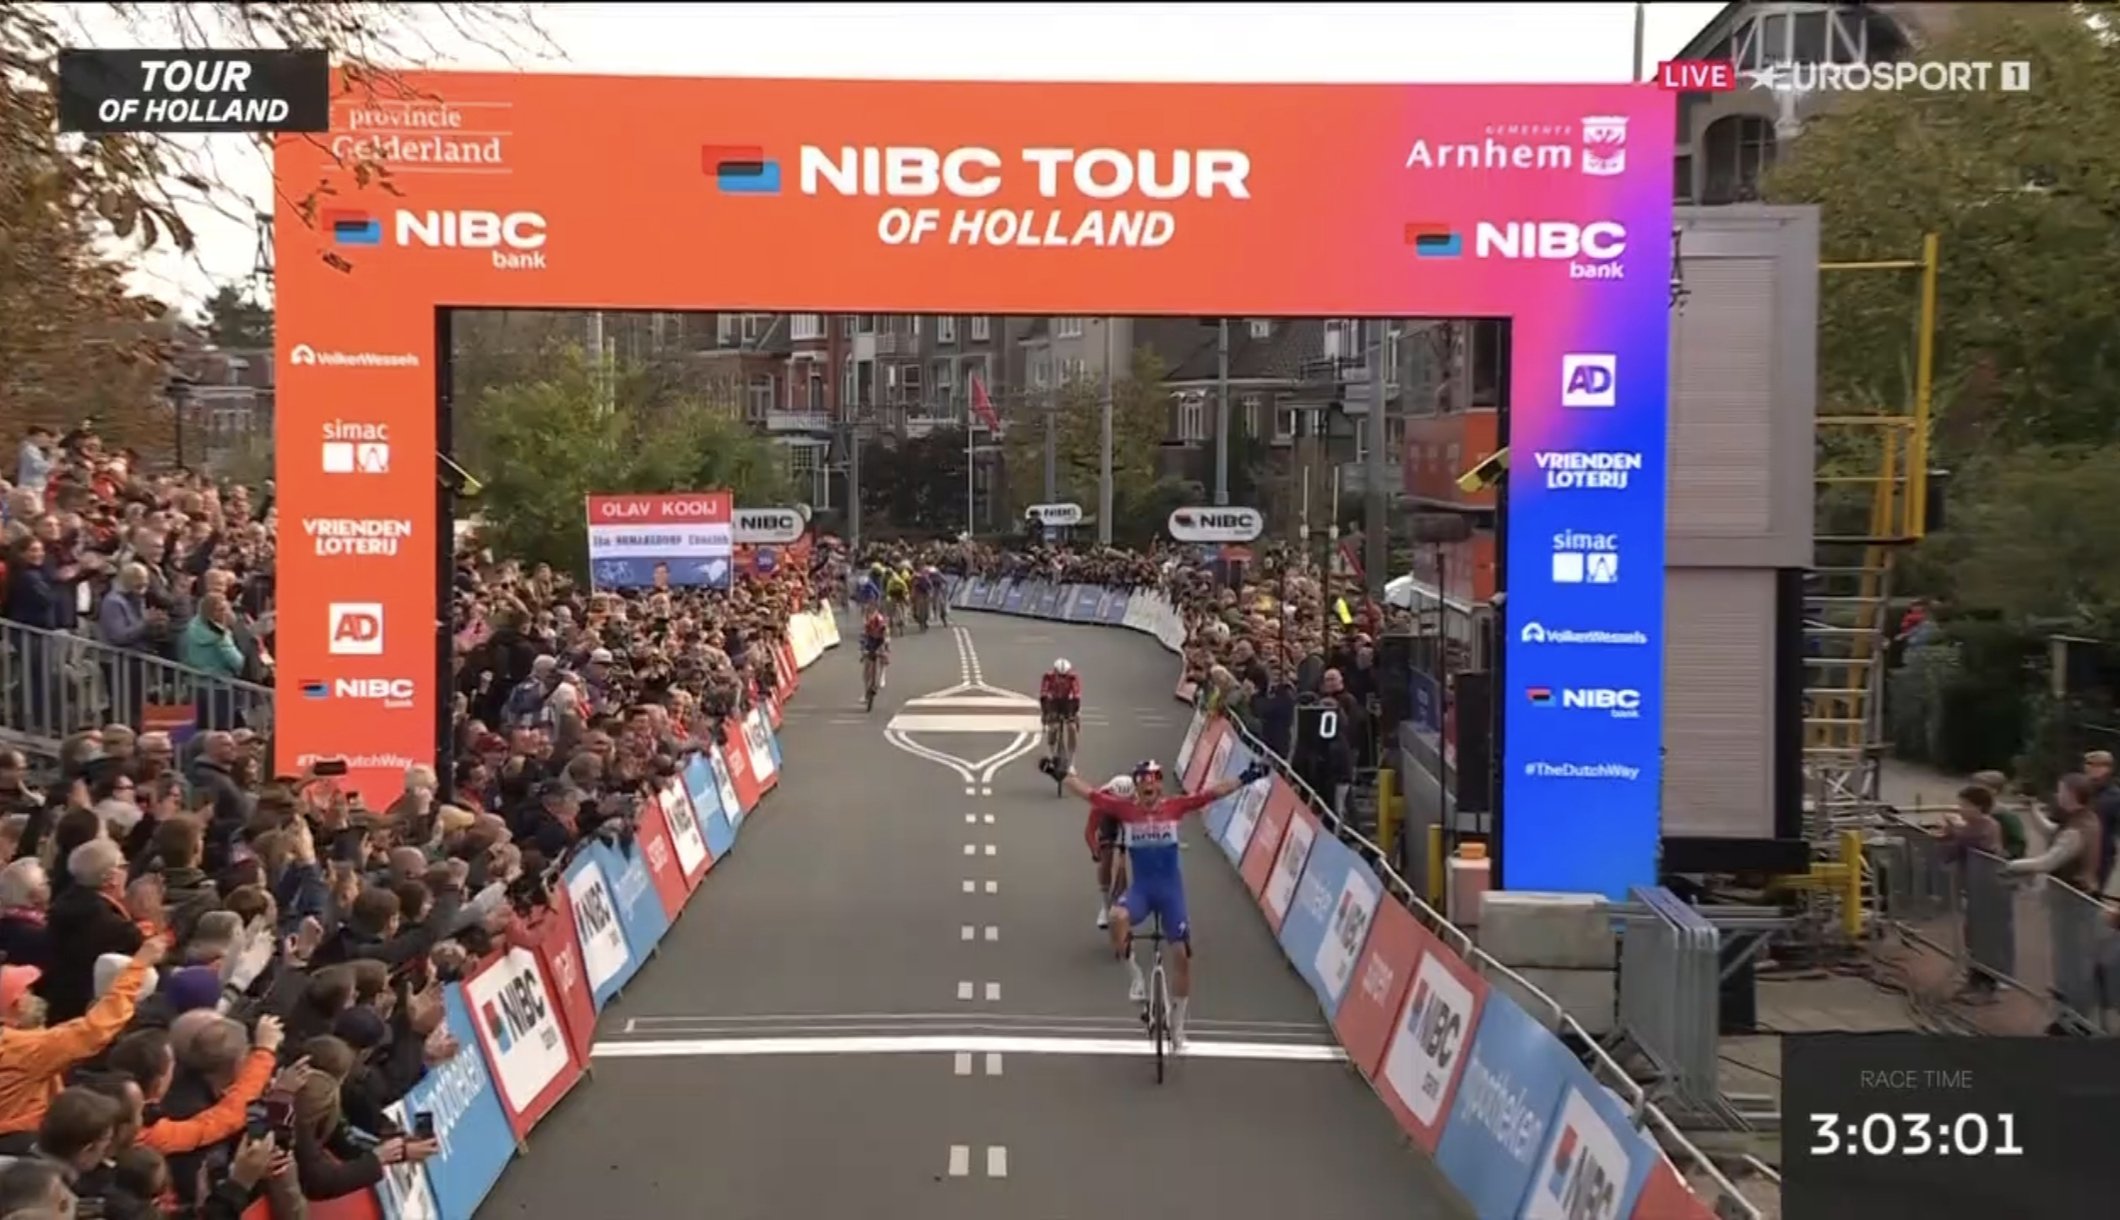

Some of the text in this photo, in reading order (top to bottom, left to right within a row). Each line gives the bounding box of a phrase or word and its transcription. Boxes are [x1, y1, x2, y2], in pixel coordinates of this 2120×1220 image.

[350, 103, 462, 130] provincie
[331, 135, 502, 163] Gelderland
[1405, 138, 1572, 169] Arnhem
[800, 145, 1250, 199] NIBC TOUR
[396, 210, 546, 248] NIBC
[877, 208, 1175, 247] OF HOLLAND
[1476, 222, 1627, 258] NIBC
[492, 250, 546, 269] bank
[1570, 261, 1624, 278] bank
[317, 352, 418, 367] VolkerWessels
[1567, 365, 1611, 394] AD
[323, 419, 388, 440] simac
[1534, 452, 1642, 469] VRIENDEN
[1546, 470, 1628, 488] LOTERIJ
[602, 501, 717, 517] OLAV KOOIJ
[303, 518, 411, 536] VRIENDEN
[740, 515, 795, 530] NIBC
[1200, 513, 1253, 528] NIBC
[315, 537, 398, 556] LOTERIJ
[1552, 529, 1618, 550] simac
[334, 612, 379, 641] AD
[335, 679, 414, 698] NIBC
[1562, 688, 1641, 708] NIBC
[1319, 711, 1338, 739] 0
[296, 753, 413, 770] #TDutchWay
[1525, 762, 1640, 780] #TheDutchWay
[498, 968, 546, 1042] NIBC
